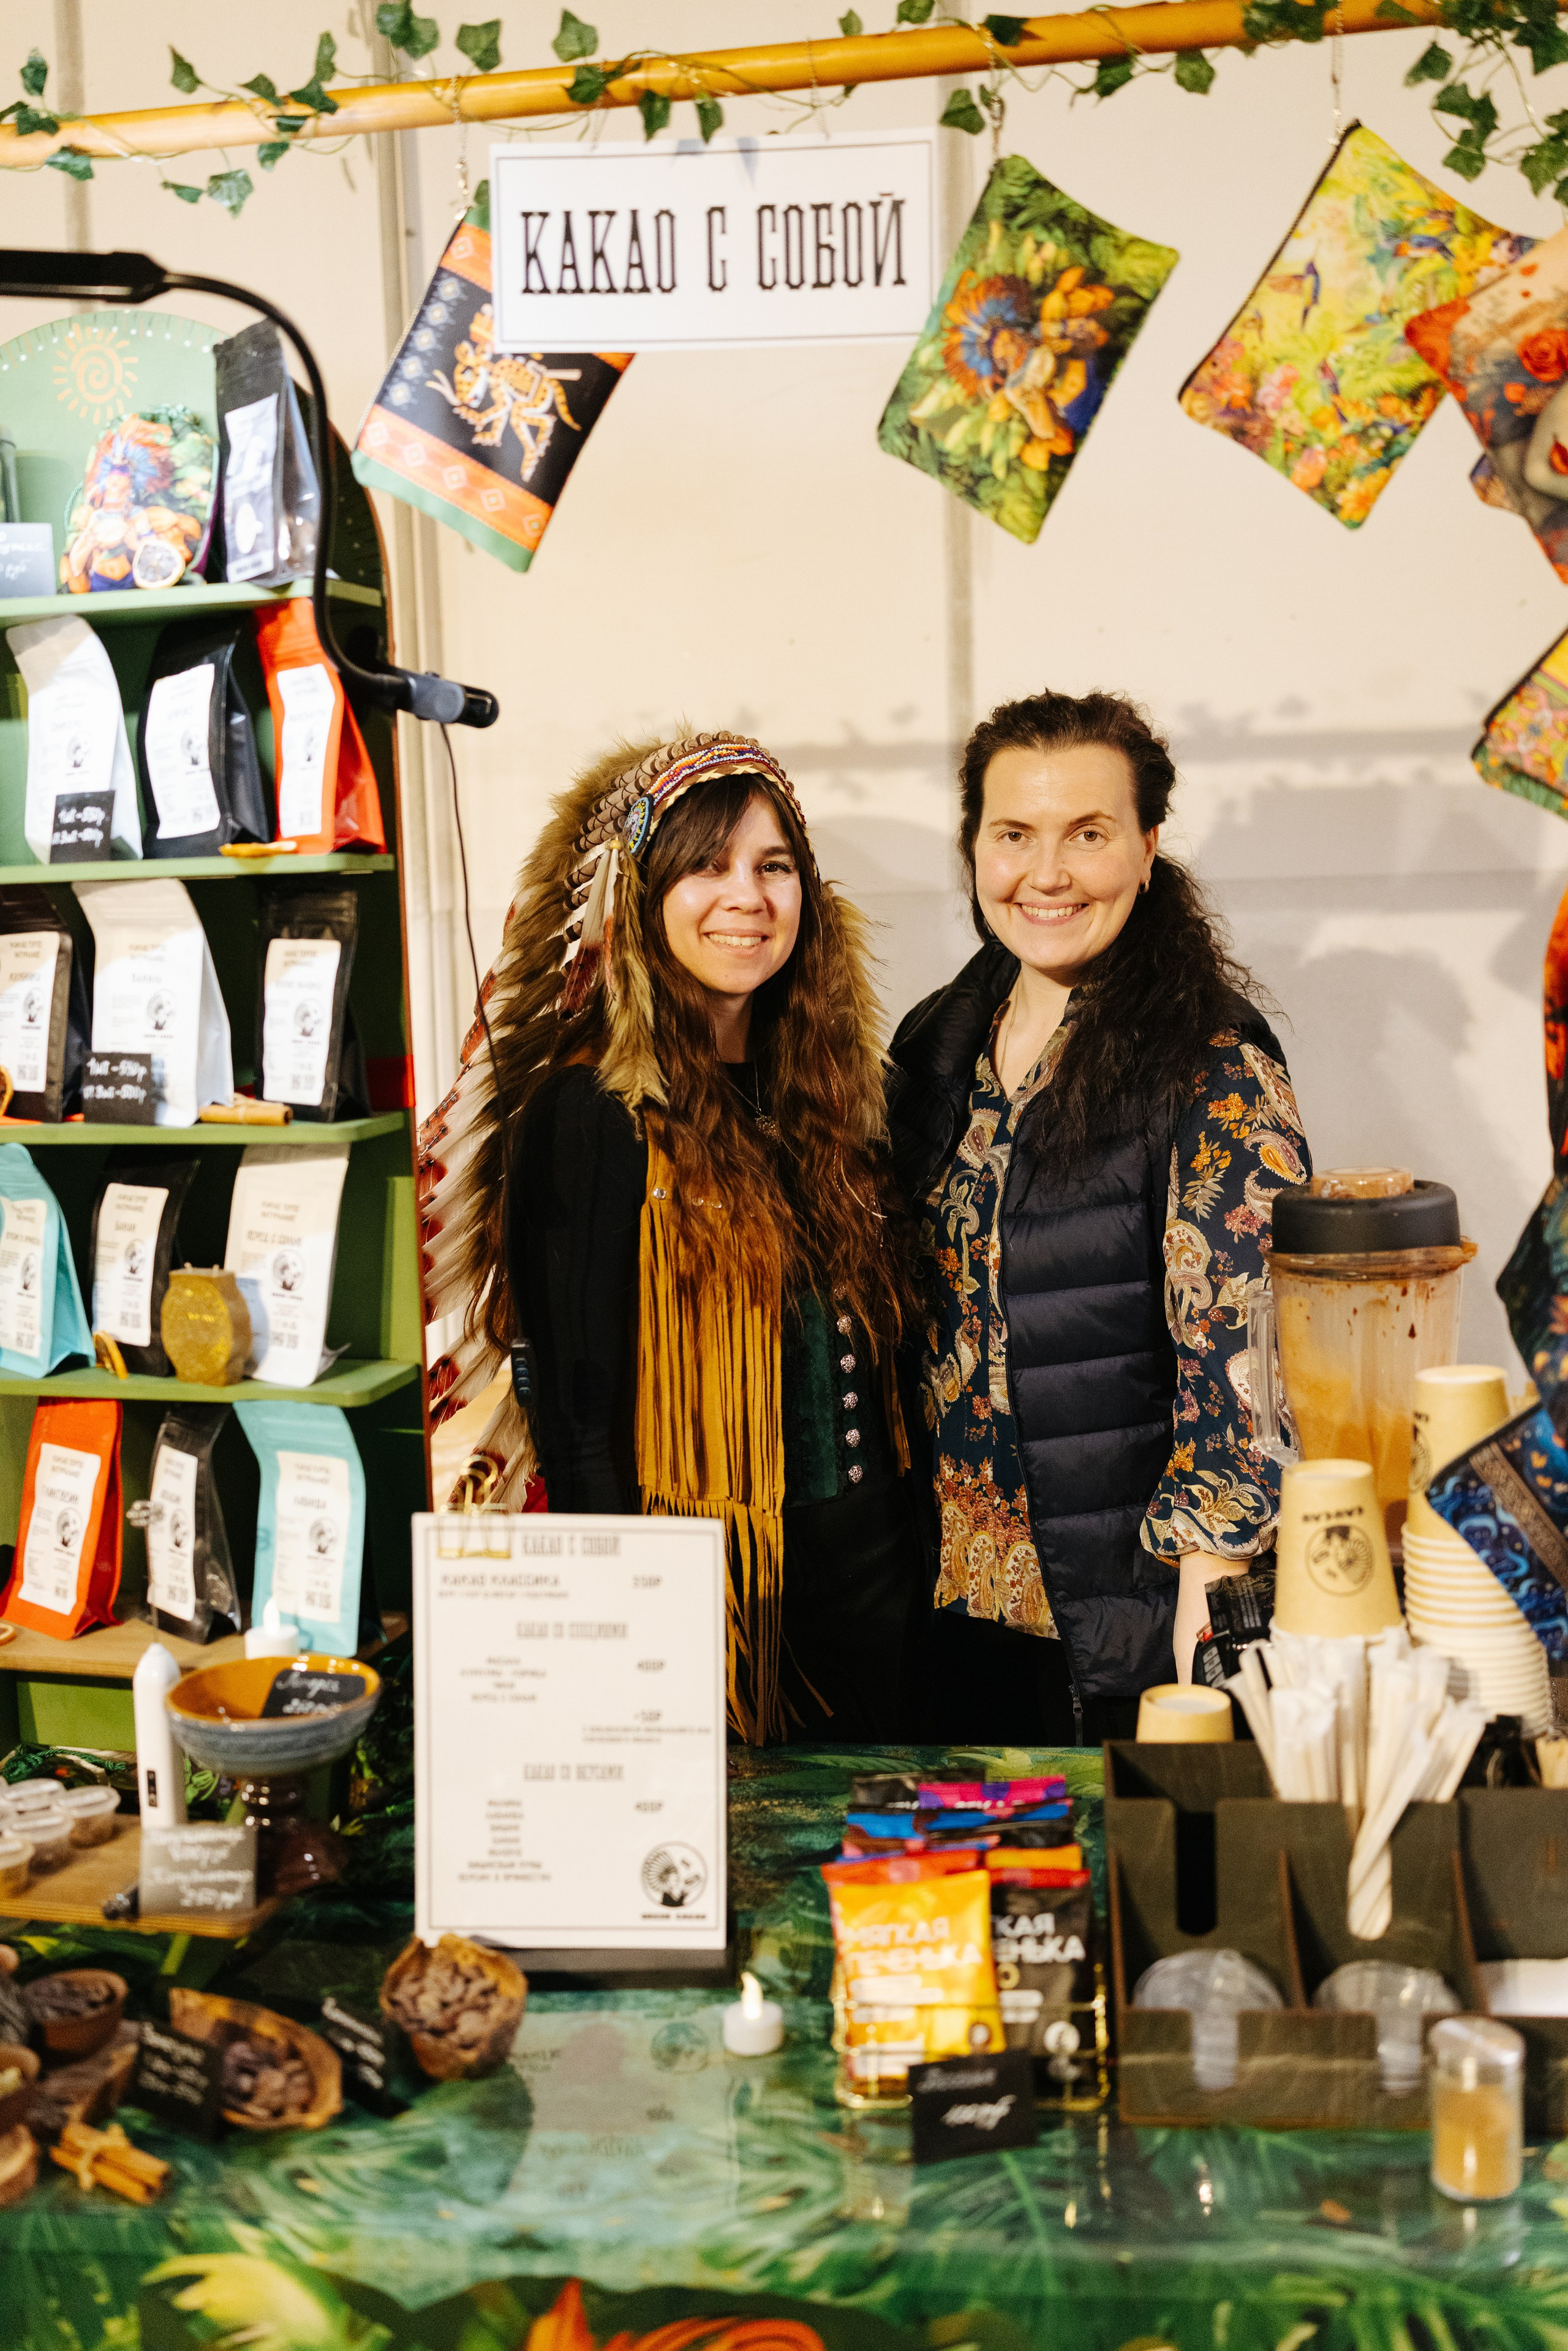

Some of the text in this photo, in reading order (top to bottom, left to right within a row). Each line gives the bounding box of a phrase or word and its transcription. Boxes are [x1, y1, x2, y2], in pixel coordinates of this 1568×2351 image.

[520, 192, 907, 294] КАКАО С СОБОЙ
[990, 1912, 1055, 1938] КАЯ
[992, 1936, 1087, 1963] ЕНЬКА
